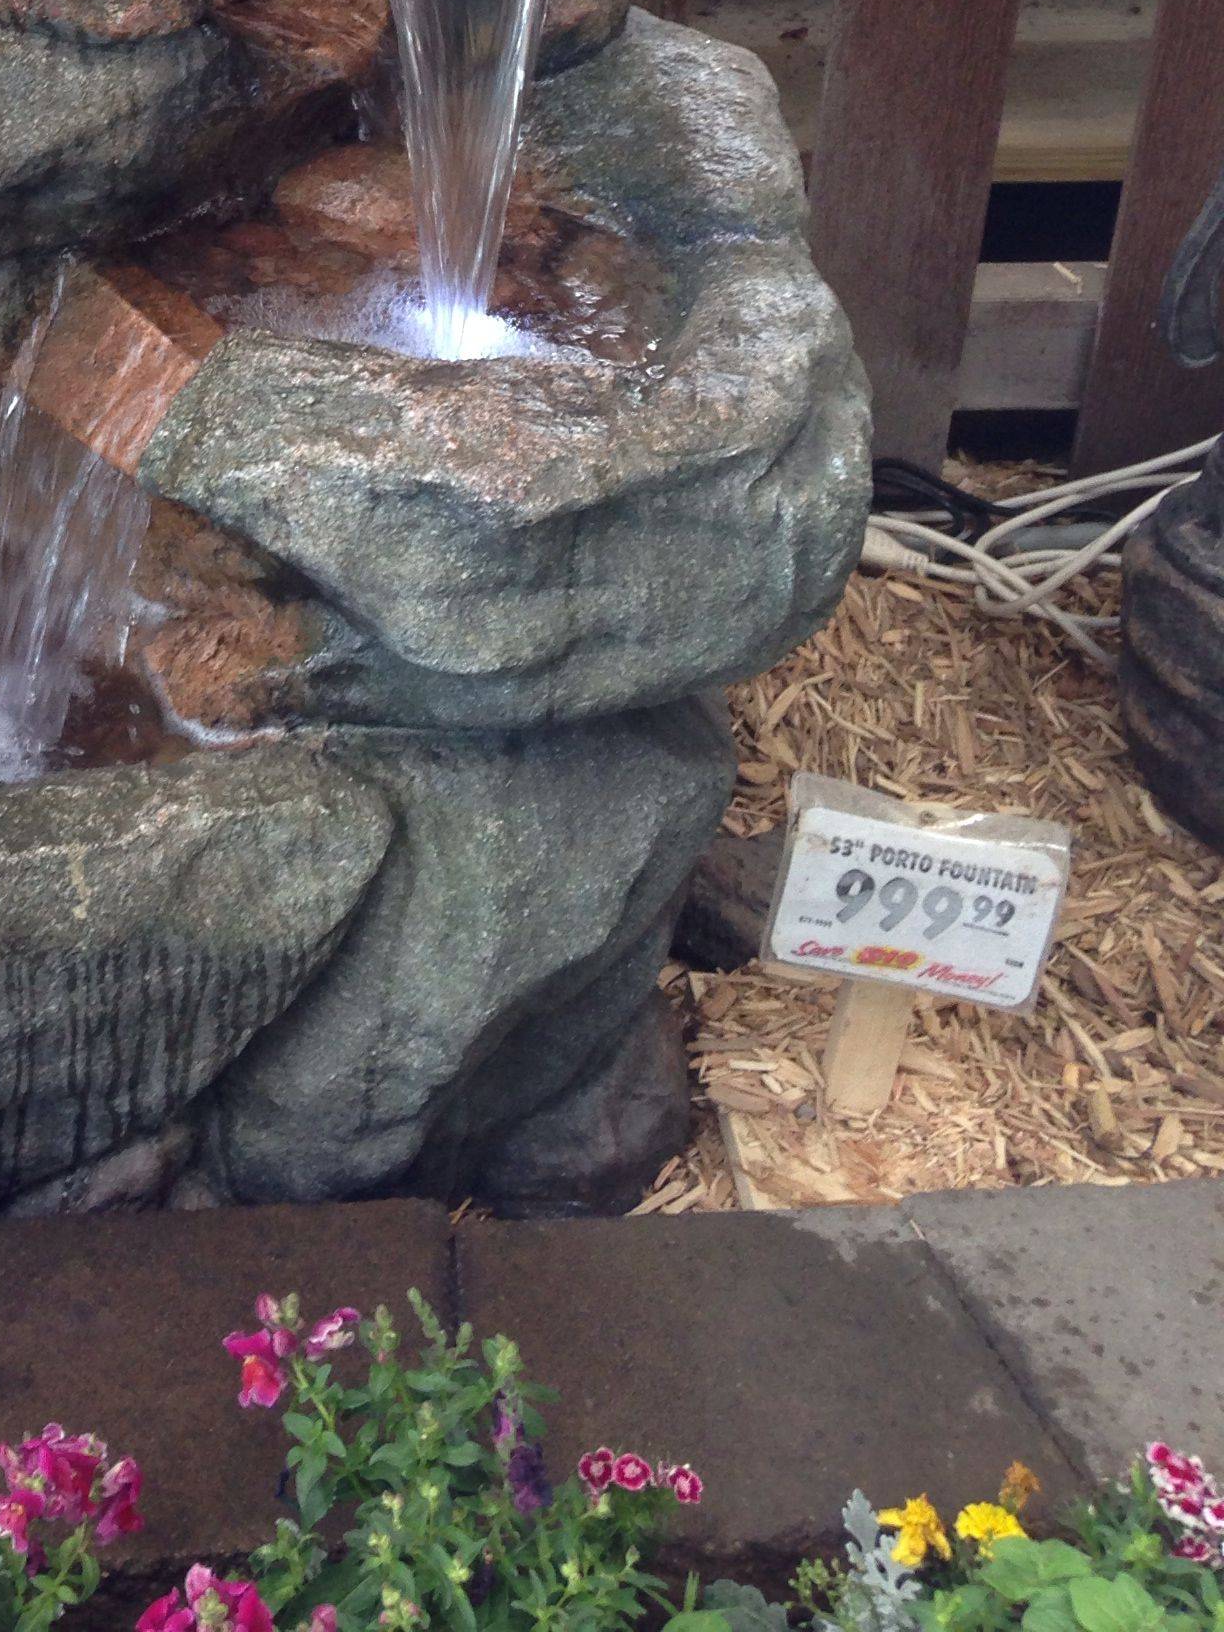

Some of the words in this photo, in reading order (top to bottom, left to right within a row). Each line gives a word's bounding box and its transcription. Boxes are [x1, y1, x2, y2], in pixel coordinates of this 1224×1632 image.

[830, 835, 865, 857] 53"
[870, 843, 933, 873] PORTO
[938, 858, 1040, 895] FOUNTAIN
[796, 939, 845, 958] Save
